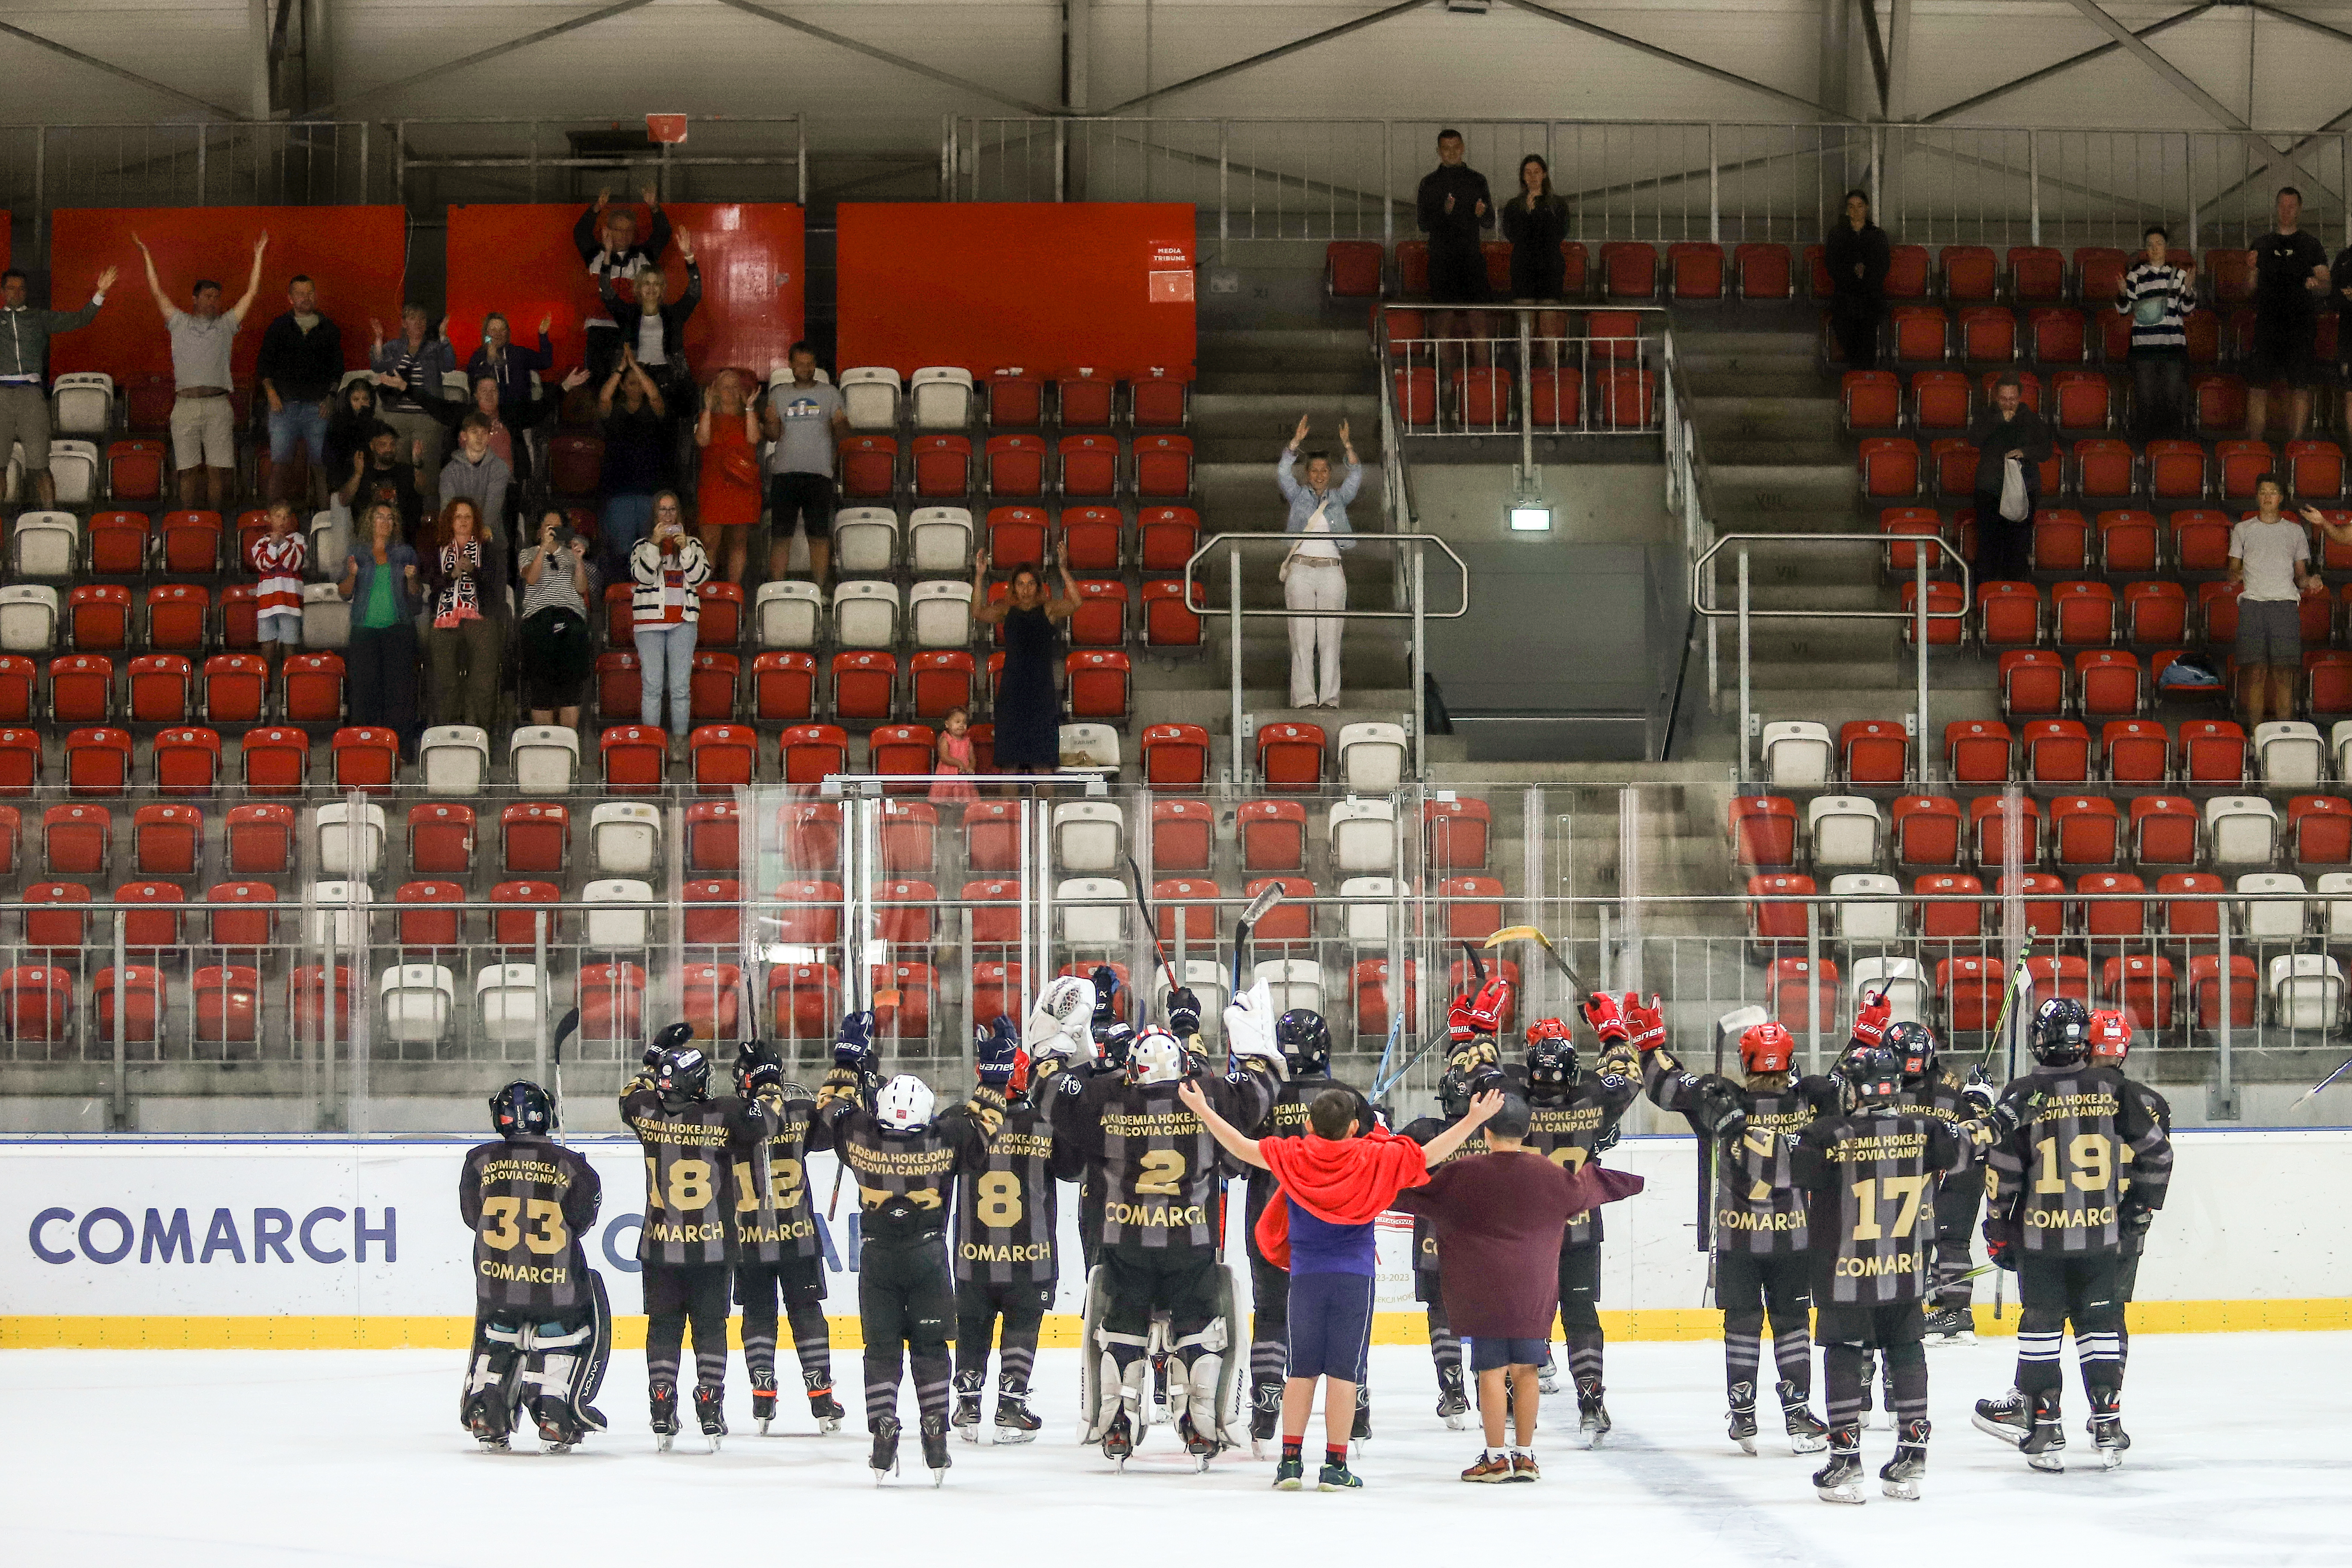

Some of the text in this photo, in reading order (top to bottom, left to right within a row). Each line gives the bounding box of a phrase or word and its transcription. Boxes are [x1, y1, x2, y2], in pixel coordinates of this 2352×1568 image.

[733, 1158, 804, 1213] 12
[1134, 1149, 1187, 1196] 2
[2035, 1133, 2112, 1194] 19
[482, 1195, 567, 1255] 33
[977, 1170, 1022, 1228] 8
[1718, 1209, 1807, 1231] COMARCH
[1851, 1175, 1922, 1240] 17
[29, 1207, 397, 1265] COMARCH
[480, 1259, 567, 1285] COMARCH
[581, 1360, 601, 1397] VAPOR
